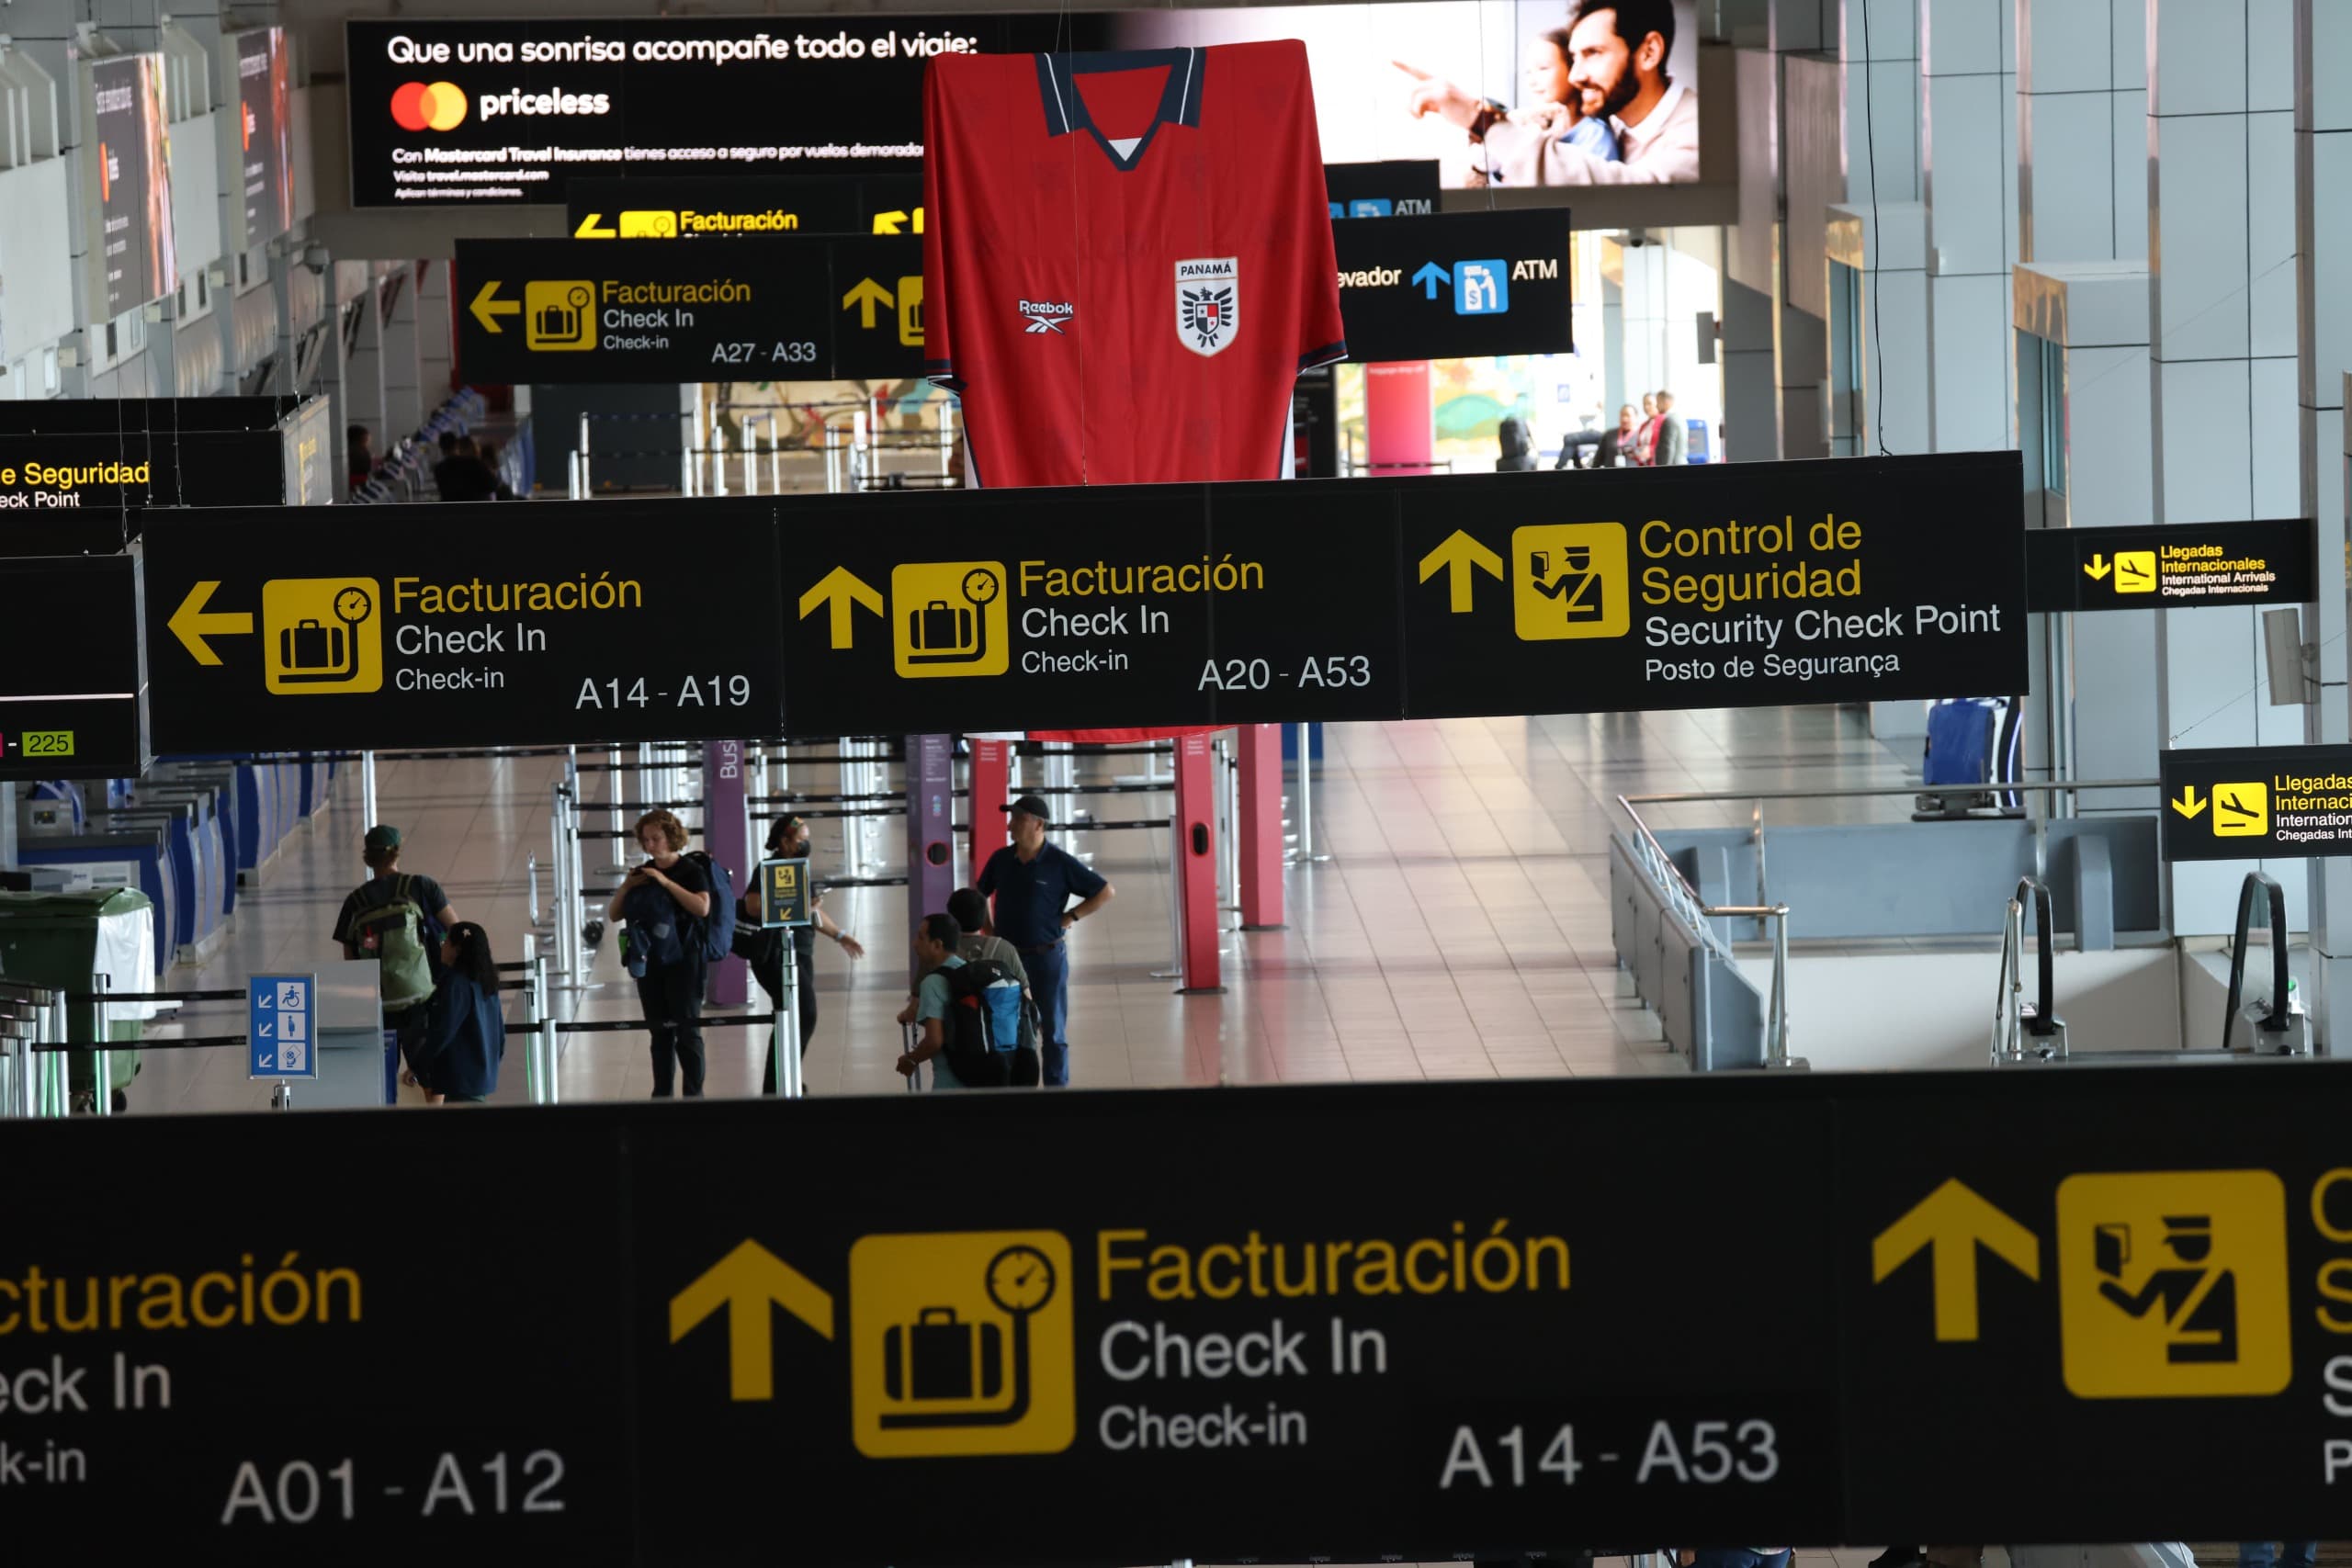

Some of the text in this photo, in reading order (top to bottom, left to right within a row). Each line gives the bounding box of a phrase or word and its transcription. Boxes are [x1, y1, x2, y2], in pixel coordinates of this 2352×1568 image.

[388, 36, 450, 63] Que
[458, 43, 513, 62] una
[521, 36, 626, 62] sonrisa
[633, 34, 789, 65] acompañe
[795, 31, 865, 59] todo
[871, 31, 896, 58] el
[481, 87, 610, 121] priceless
[392, 148, 423, 164] Con
[424, 147, 507, 163] Mastercard
[508, 147, 552, 162] Travel
[554, 147, 623, 162] Insurance
[624, 146, 666, 161] tienes
[667, 148, 716, 160] acceso
[729, 147, 777, 162] seguro
[779, 147, 803, 161] por
[804, 143, 849, 158] vuelos
[393, 171, 426, 182] Visita
[1396, 199, 1431, 216] ATM
[681, 209, 797, 231] Facturación
[1181, 261, 1232, 275] PANAMÁ
[1512, 259, 1557, 280] ATM
[603, 279, 750, 303] Facturación
[604, 309, 694, 328] Check In
[1019, 300, 1073, 314] Reebok
[604, 335, 669, 349] Check-in
[712, 344, 755, 362] A27
[772, 342, 816, 362] A33
[25, 461, 150, 490] Seguridad
[35, 491, 80, 507] Point
[1640, 513, 1861, 558] Control de
[2161, 545, 2223, 560] Llegadas
[1021, 554, 1263, 596] Facturación
[2161, 558, 2266, 573] Internacionales
[2162, 570, 2276, 585] International Arrivals
[394, 571, 641, 613] Facturación
[1642, 558, 1861, 612] Seguridad
[2162, 583, 2268, 596] Chegadas Internacionais
[1023, 605, 1169, 637] Check In
[1646, 604, 2000, 649] Security Check Point
[396, 623, 545, 654] Check In
[1022, 649, 1127, 673] Check-in
[1646, 654, 1900, 681] Posto de Segurança
[396, 667, 503, 690] Check-in
[1198, 659, 1270, 691] A20
[1298, 656, 1370, 687] A53
[576, 678, 649, 709] A14
[677, 675, 750, 706] A19
[29, 735, 69, 752] 225
[2275, 773, 2352, 795] Llegadas
[2276, 793, 2352, 810] Internaci
[2277, 829, 2335, 842] Chegadas
[1098, 1219, 1569, 1300] Facturación
[1101, 1317, 1385, 1380] Check In
[115, 1352, 170, 1409] In
[1100, 1403, 1306, 1450] Check-in
[1441, 1425, 1582, 1488] A14
[1637, 1420, 1778, 1483] A53
[222, 1459, 353, 1524] A01
[423, 1450, 564, 1516] A12
